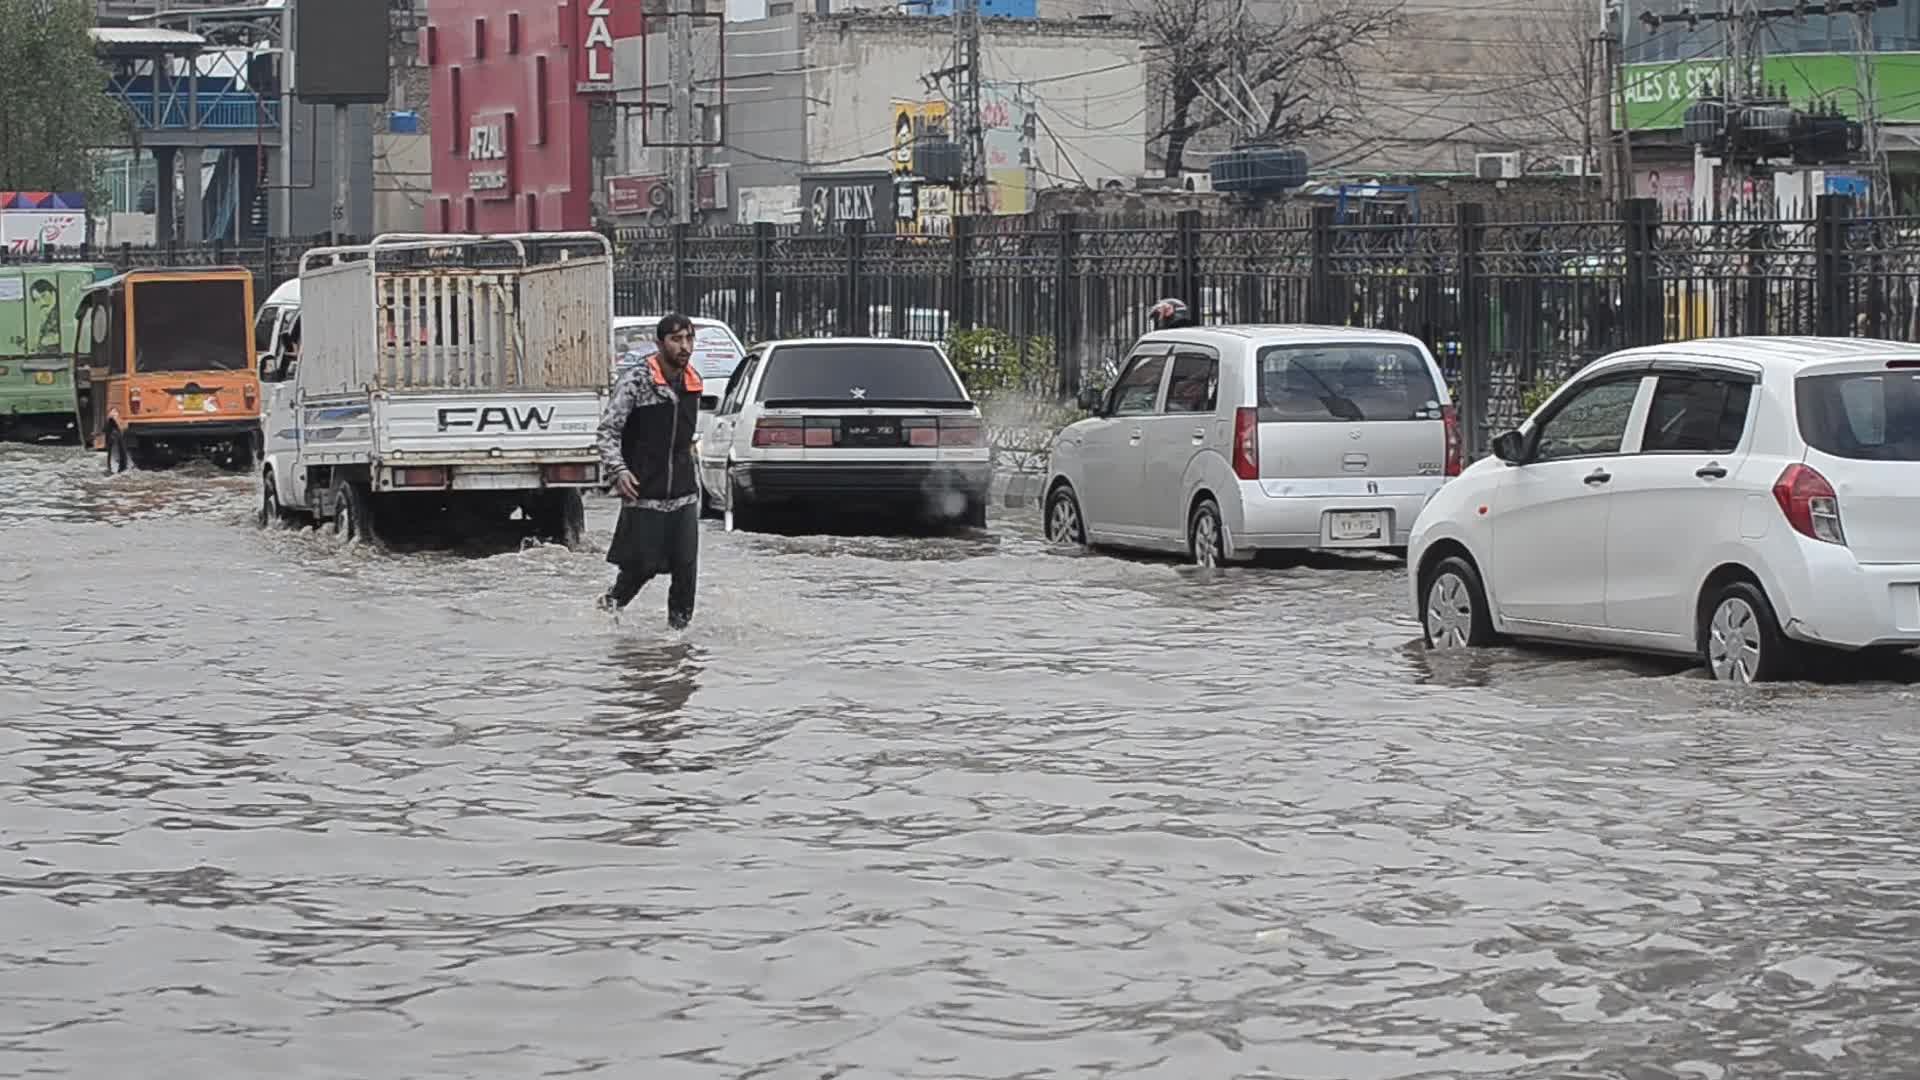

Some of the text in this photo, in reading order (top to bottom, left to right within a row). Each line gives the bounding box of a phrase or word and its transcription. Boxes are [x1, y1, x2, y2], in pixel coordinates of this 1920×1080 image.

[1619, 70, 1663, 103] ALES
[1668, 70, 1680, 100] &
[437, 406, 556, 432] FAW
